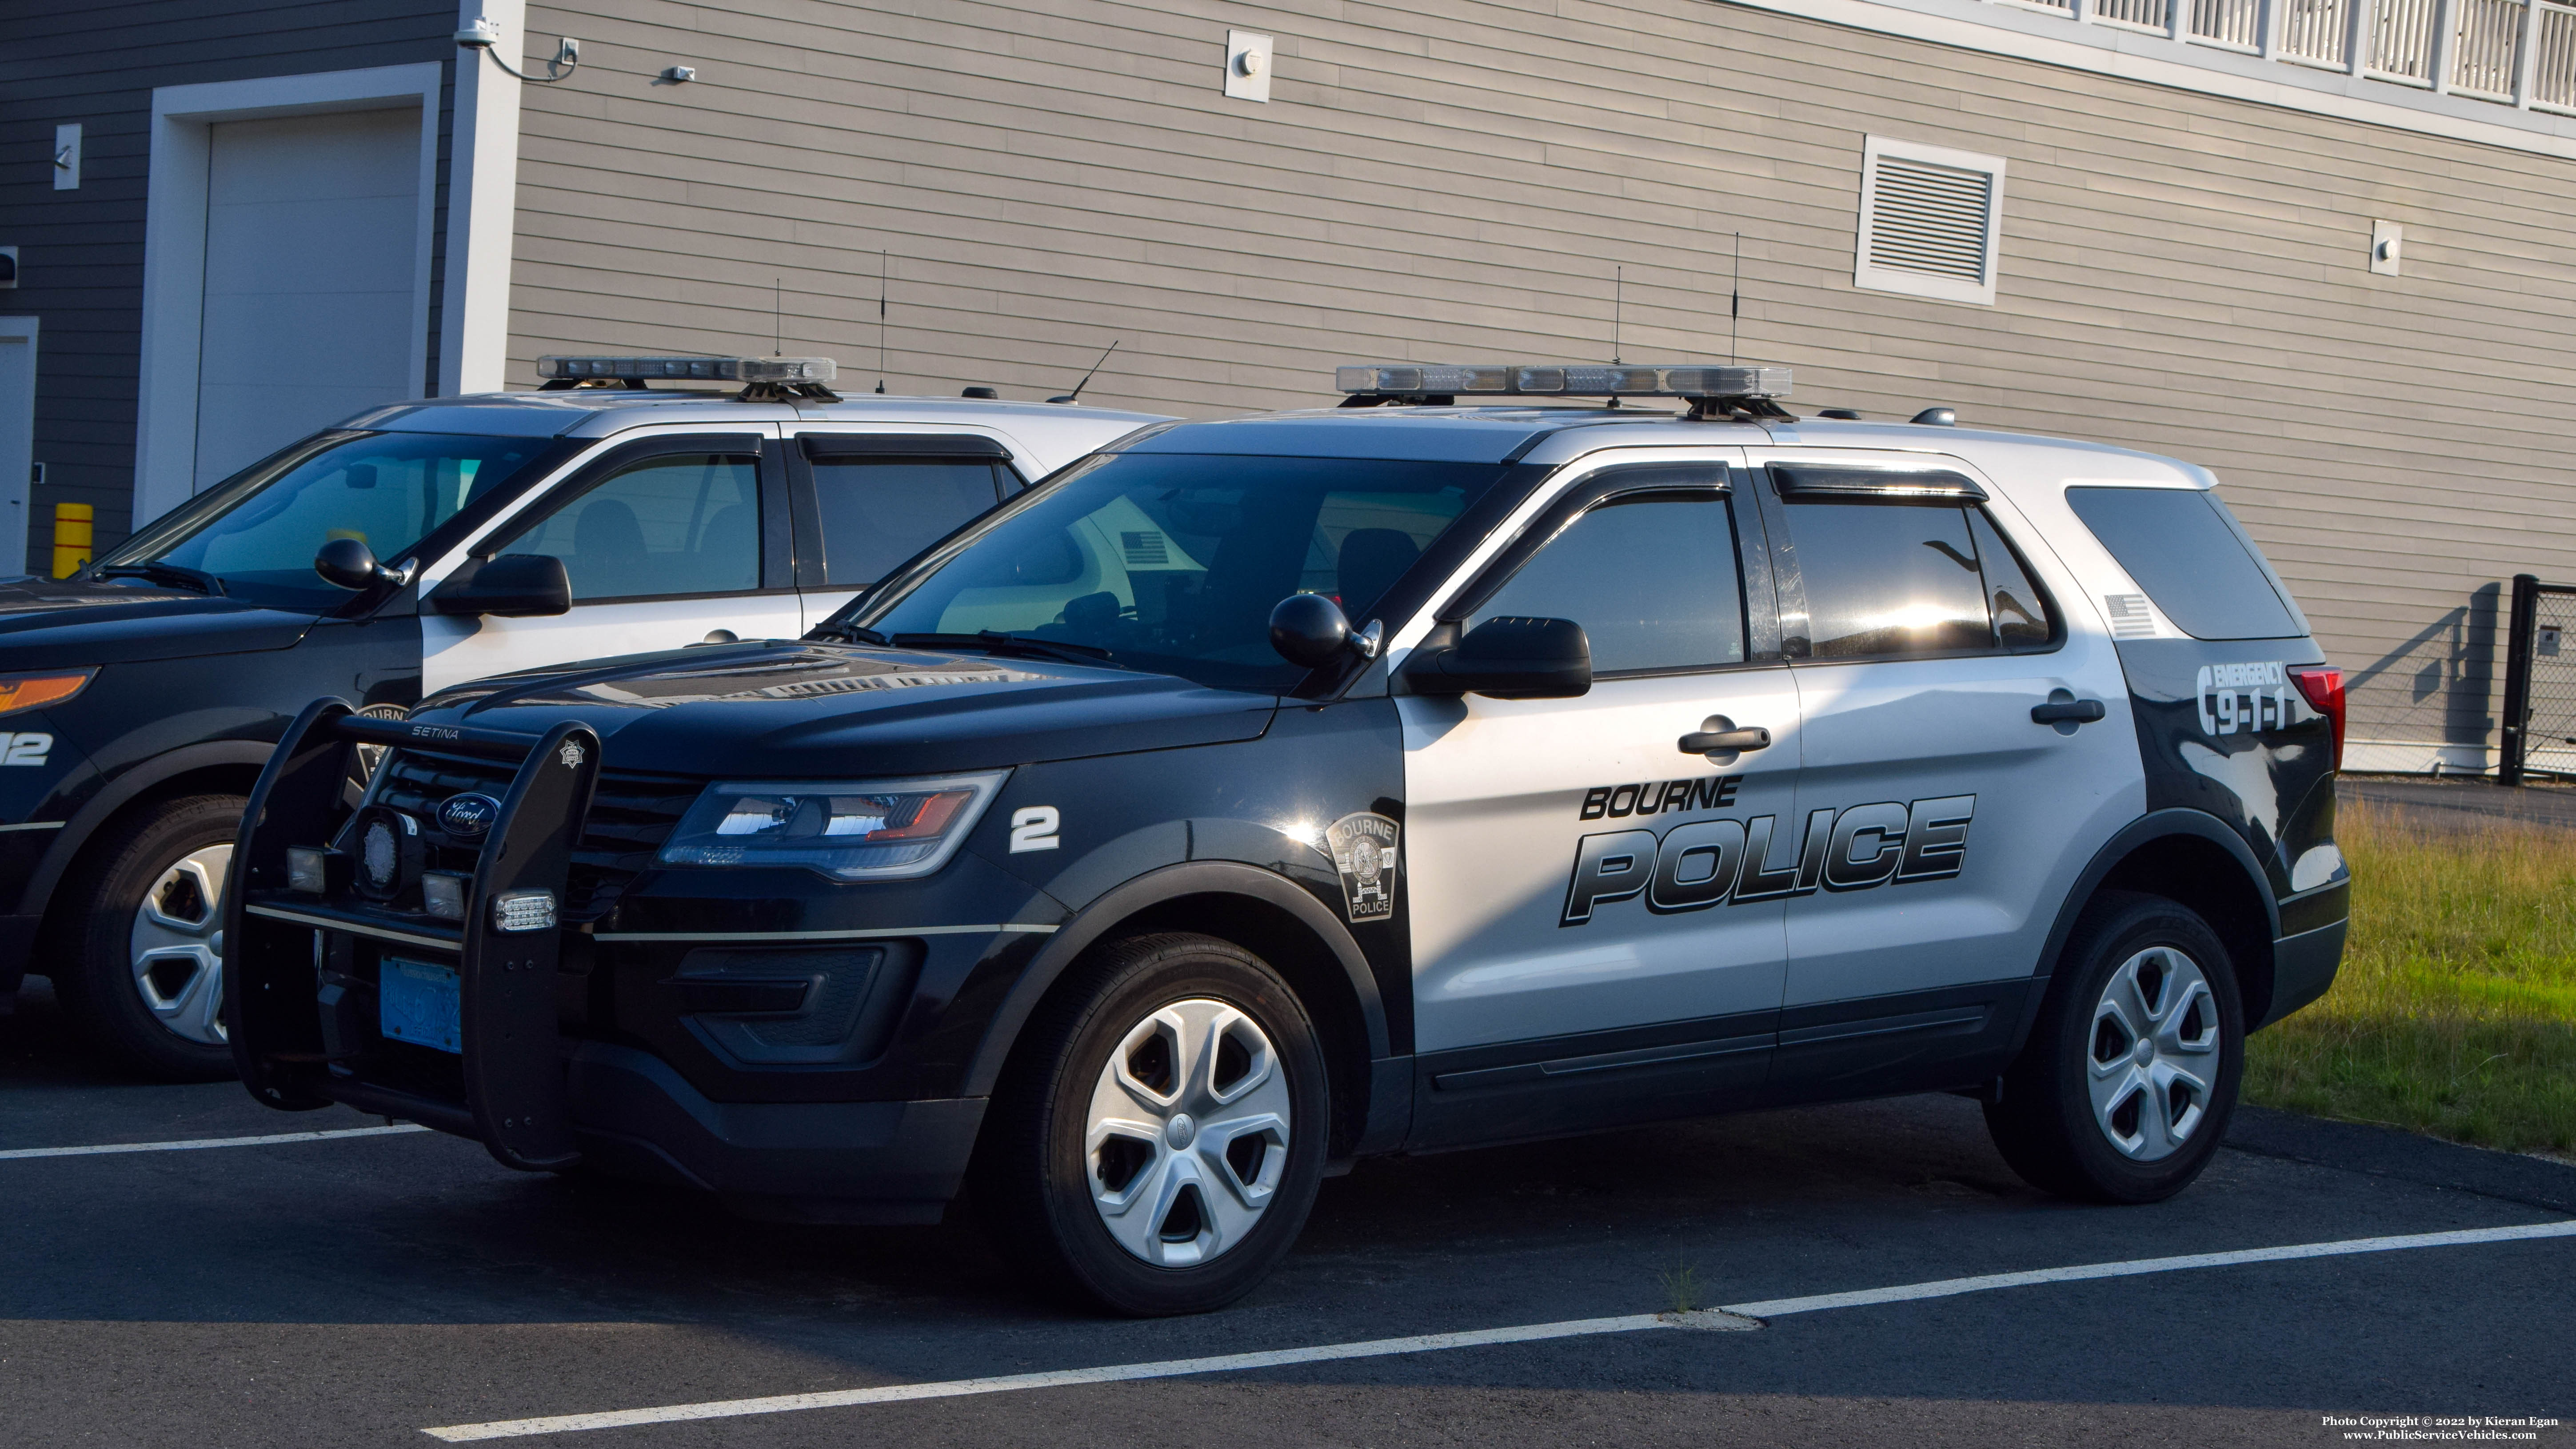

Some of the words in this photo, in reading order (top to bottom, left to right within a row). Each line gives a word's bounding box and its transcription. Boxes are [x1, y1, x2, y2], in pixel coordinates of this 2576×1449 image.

[2213, 661, 2282, 688] EMERGENCY
[2217, 686, 2285, 735] 9-1-1
[412, 726, 459, 739] SETINA
[446, 799, 485, 822] Ford
[1579, 774, 1743, 821] BOURNE
[1010, 806, 1059, 854] 2
[1334, 819, 1394, 846] BOURNE
[1558, 793, 1976, 928] POLICE
[1353, 900, 1389, 915] POLICE
